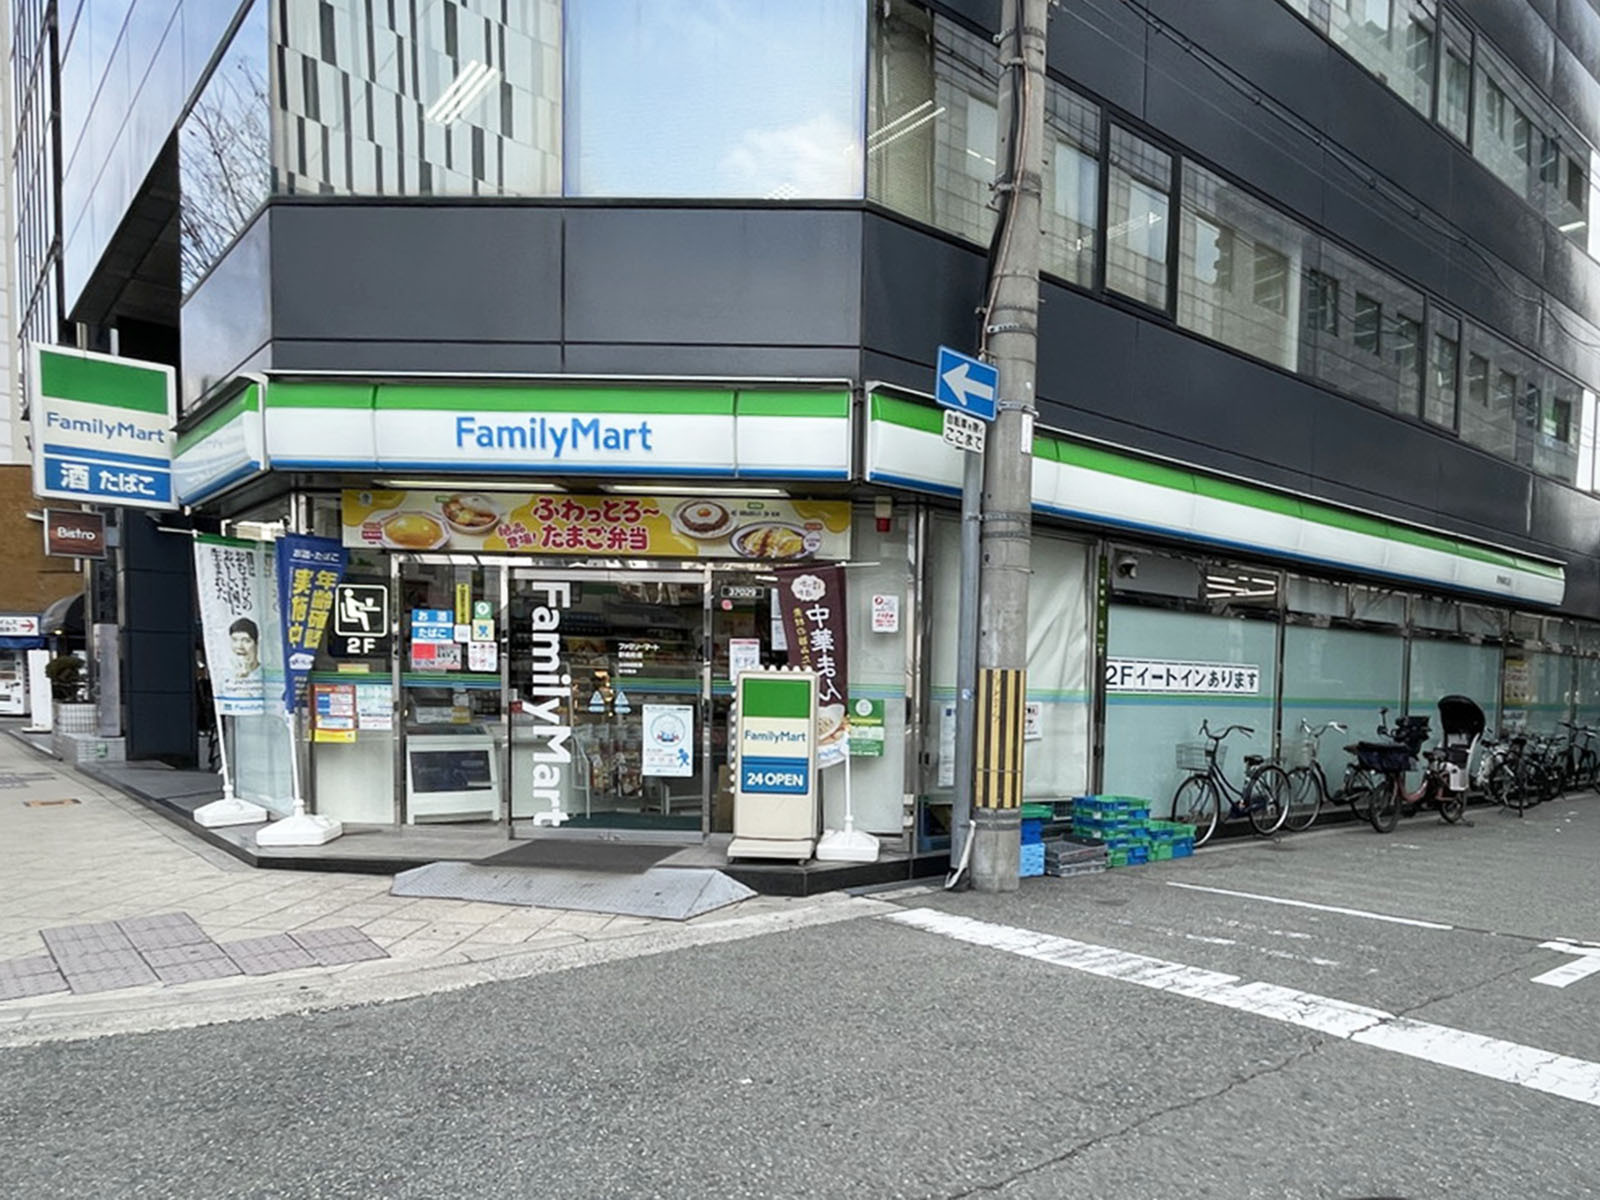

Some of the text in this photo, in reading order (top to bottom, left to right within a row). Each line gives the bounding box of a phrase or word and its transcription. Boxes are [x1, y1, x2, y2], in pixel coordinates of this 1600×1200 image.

[47, 412, 165, 443] FamilyMart
[455, 415, 653, 457] FamilyMart
[60, 462, 157, 496] 酒 たばこ
[56, 526, 97, 542] Bistro
[541, 524, 648, 551] たまご弁当
[346, 637, 377, 655] 2F
[417, 627, 448, 638] たばこ
[805, 603, 842, 701] 中華まん
[1105, 664, 1257, 689] 2Fイートインあります
[521, 581, 572, 828] FamilyMart
[744, 729, 806, 743] FamilyMart
